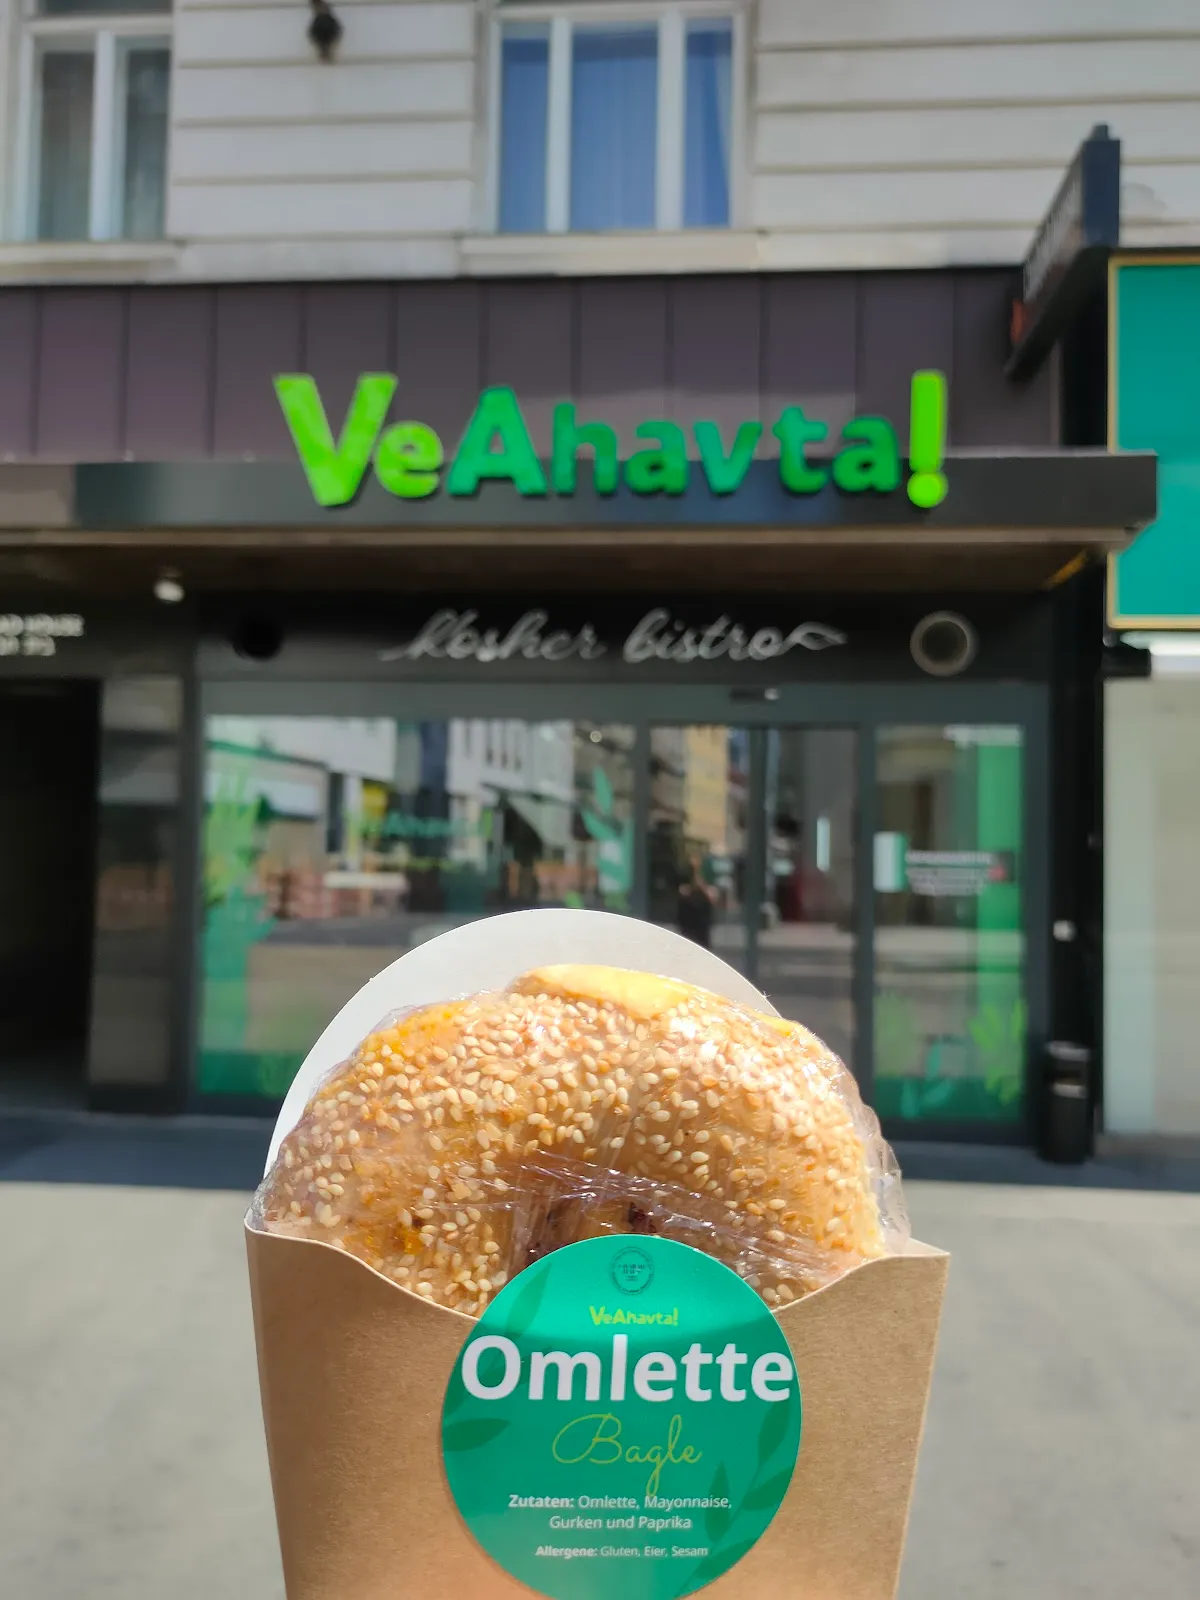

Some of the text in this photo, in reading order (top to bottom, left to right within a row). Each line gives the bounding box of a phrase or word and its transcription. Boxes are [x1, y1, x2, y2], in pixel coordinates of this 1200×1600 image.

[274, 370, 949, 508] VeAhavta!
[379, 609, 847, 661] kosher bistro
[589, 1306, 679, 1327] VeAhavta!
[460, 1333, 794, 1402] Omlette
[552, 1413, 703, 1496] Bagle
[508, 1494, 732, 1512] Zutaten: Omlette, Mayonnaise,
[549, 1515, 692, 1532] Gurken und Paprika
[535, 1545, 708, 1558] Allergene: Gluten, Eier, Sesam
